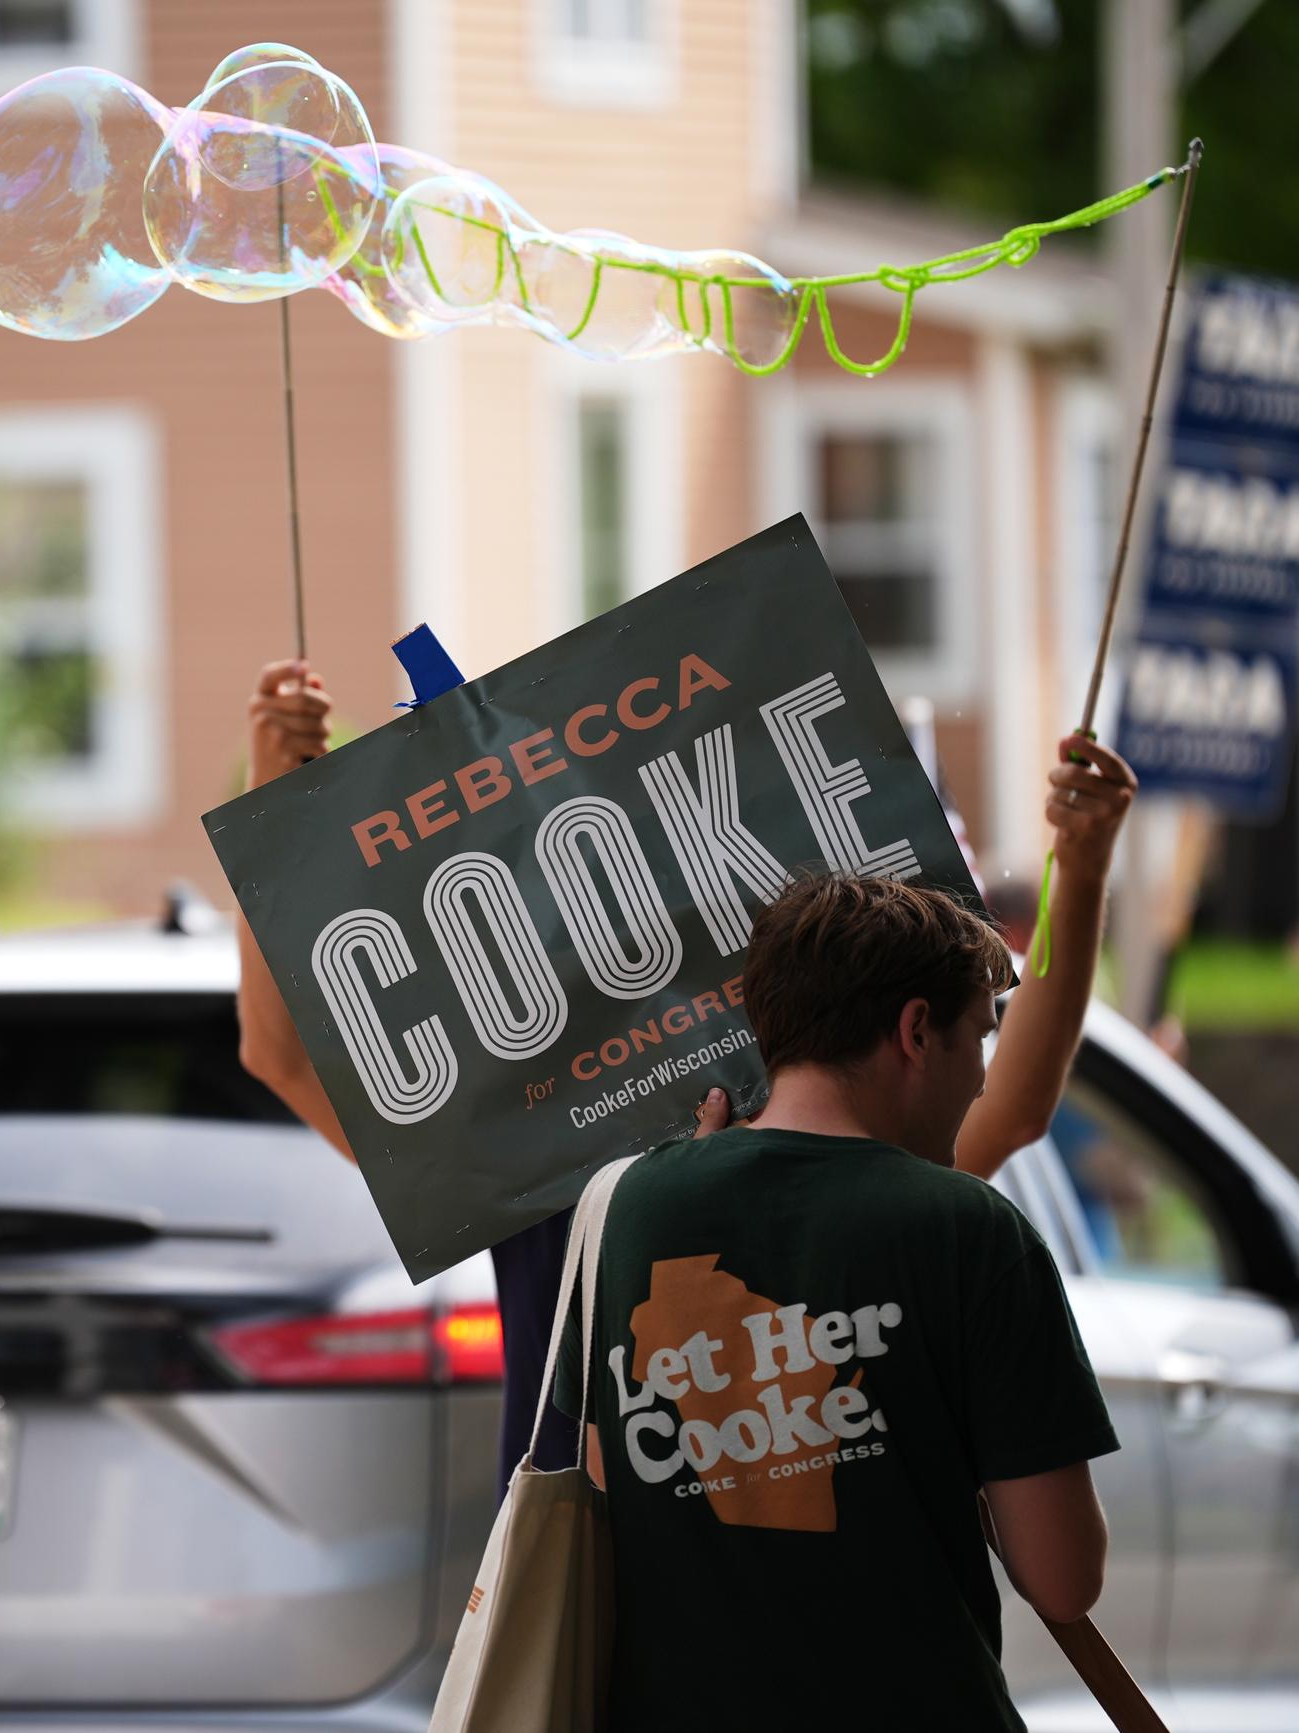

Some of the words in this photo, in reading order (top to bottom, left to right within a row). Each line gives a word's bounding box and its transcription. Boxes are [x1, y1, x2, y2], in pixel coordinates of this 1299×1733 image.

[350, 653, 732, 868] REBECCA
[311, 671, 921, 1125] COOKE
[524, 1077, 556, 1111] for
[571, 974, 746, 1081] CONGRE
[608, 1331, 731, 1418] Let
[741, 1302, 902, 1383] Her
[768, 1443, 885, 1480] CONGRESS
